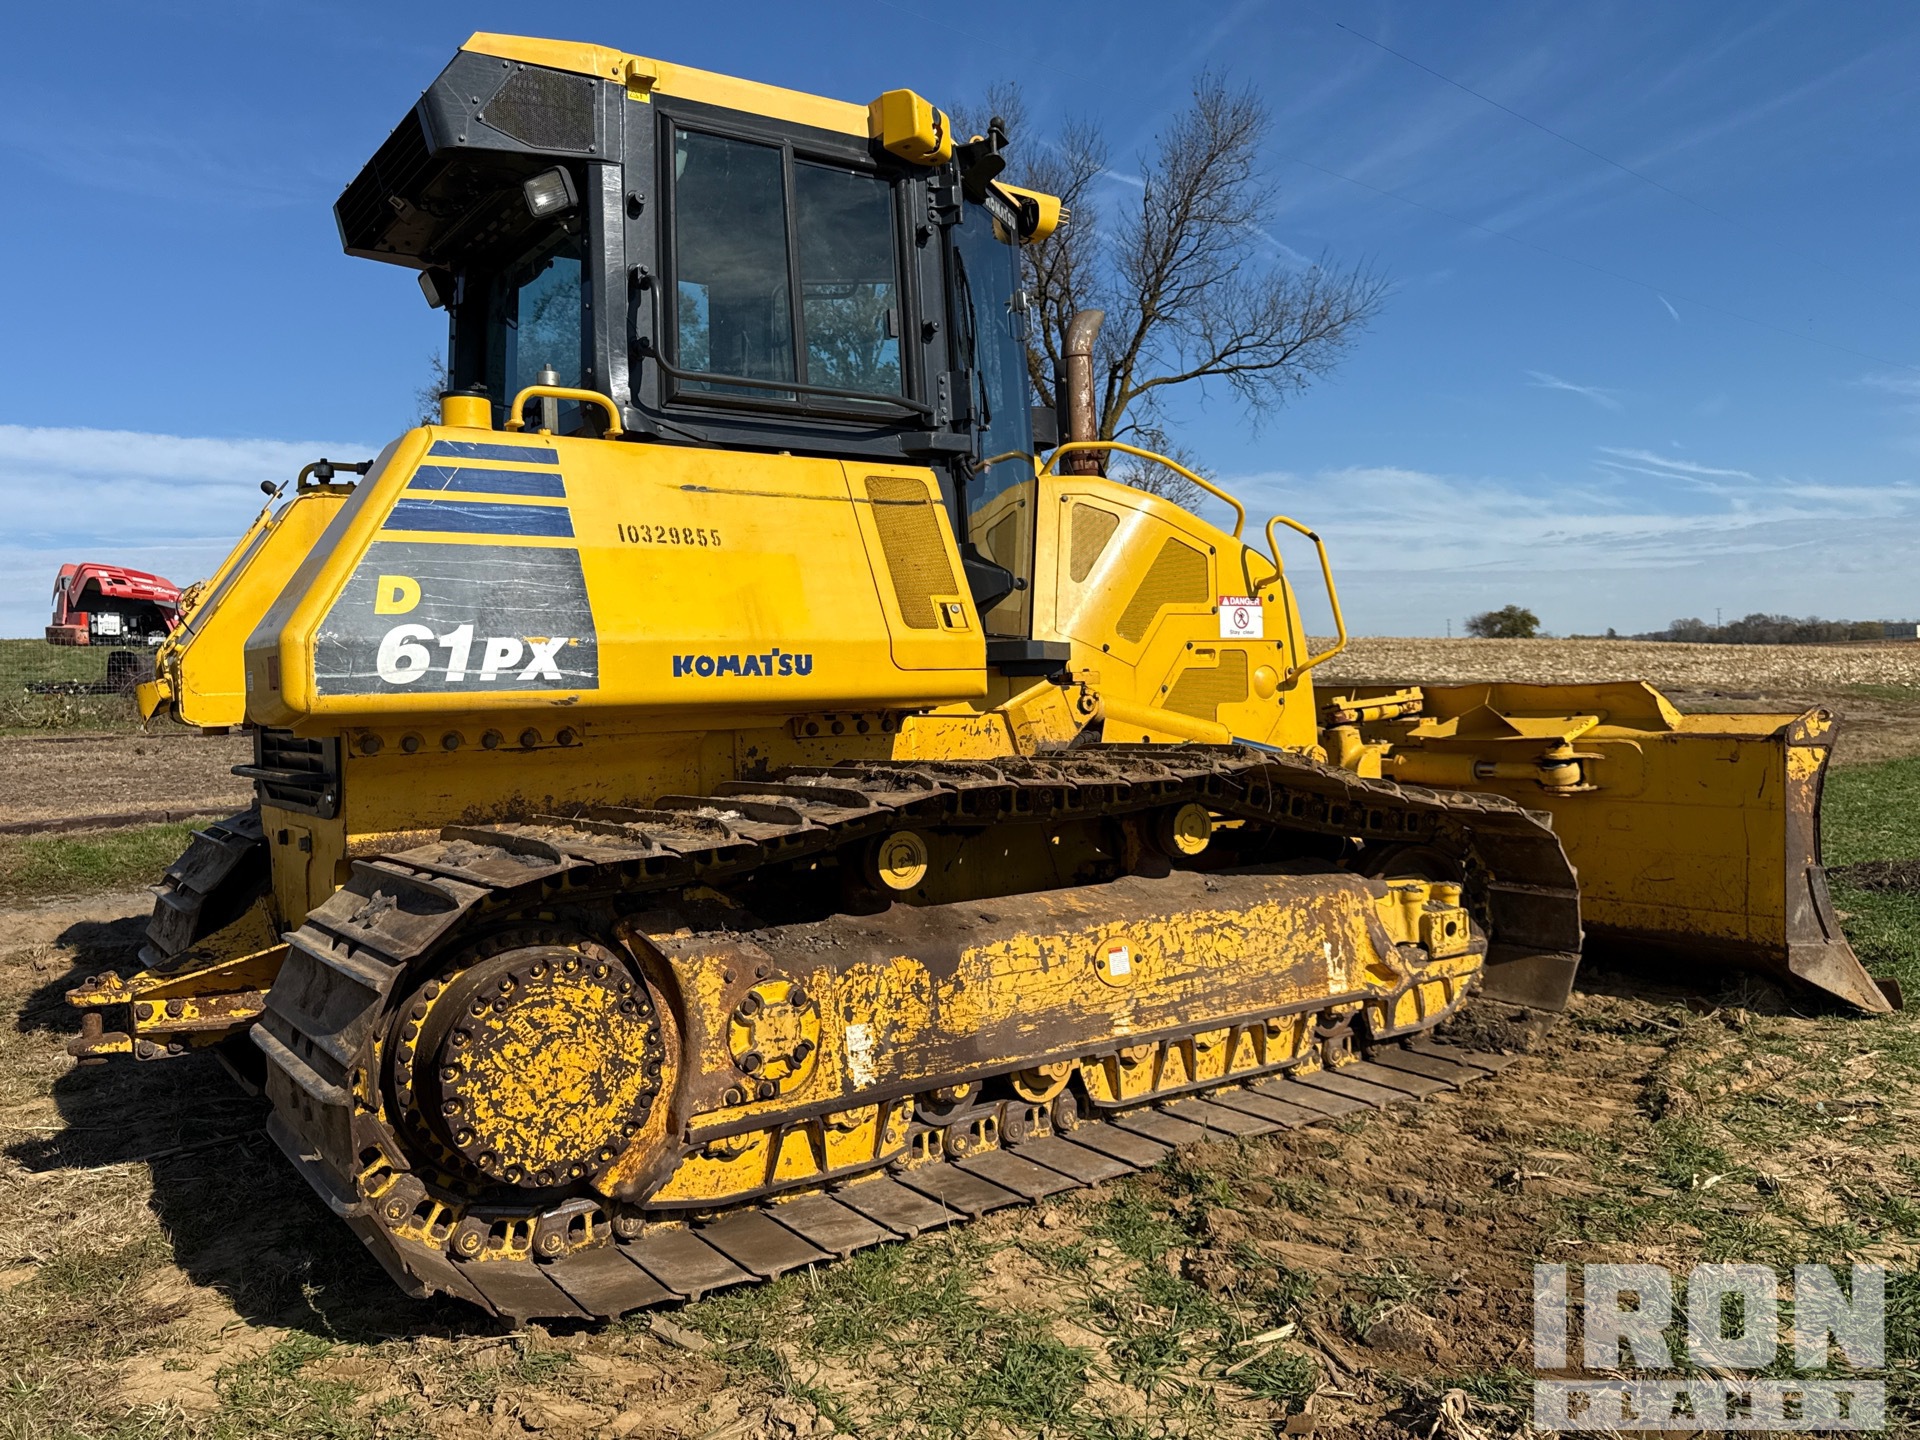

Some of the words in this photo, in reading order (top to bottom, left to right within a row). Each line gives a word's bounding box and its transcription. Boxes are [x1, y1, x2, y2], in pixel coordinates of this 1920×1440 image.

[617, 523, 721, 547] 10329855
[374, 575, 421, 614] D
[1230, 597, 1260, 606] DANGER
[672, 647, 813, 678] KOMATSU
